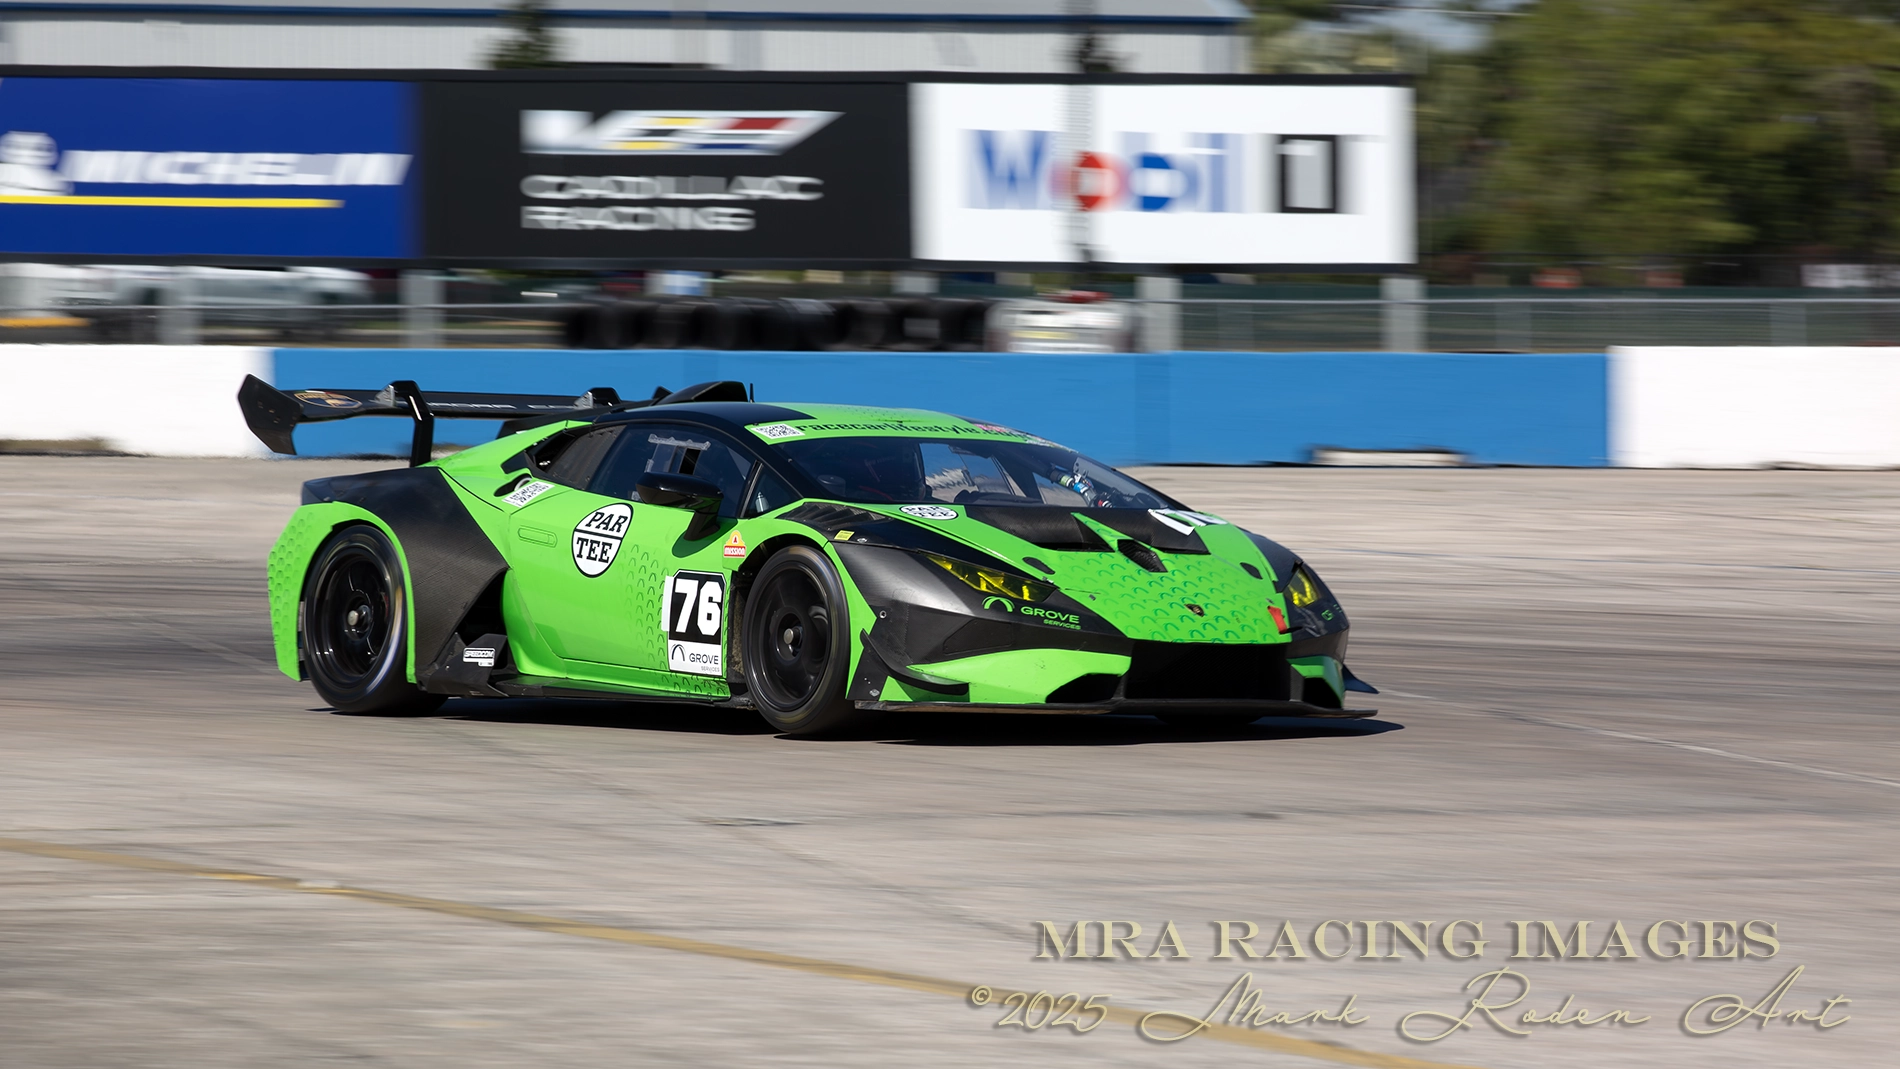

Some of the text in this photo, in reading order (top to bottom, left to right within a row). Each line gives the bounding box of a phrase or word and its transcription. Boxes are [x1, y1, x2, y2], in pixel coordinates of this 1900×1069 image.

[965, 129, 1246, 213] Mobil
[585, 511, 629, 533] PAR
[576, 536, 613, 564] TEE
[674, 577, 723, 636] 76
[1020, 606, 1080, 624] GROVE
[1043, 618, 1082, 630] SERVICES
[689, 652, 719, 665] GROVE
